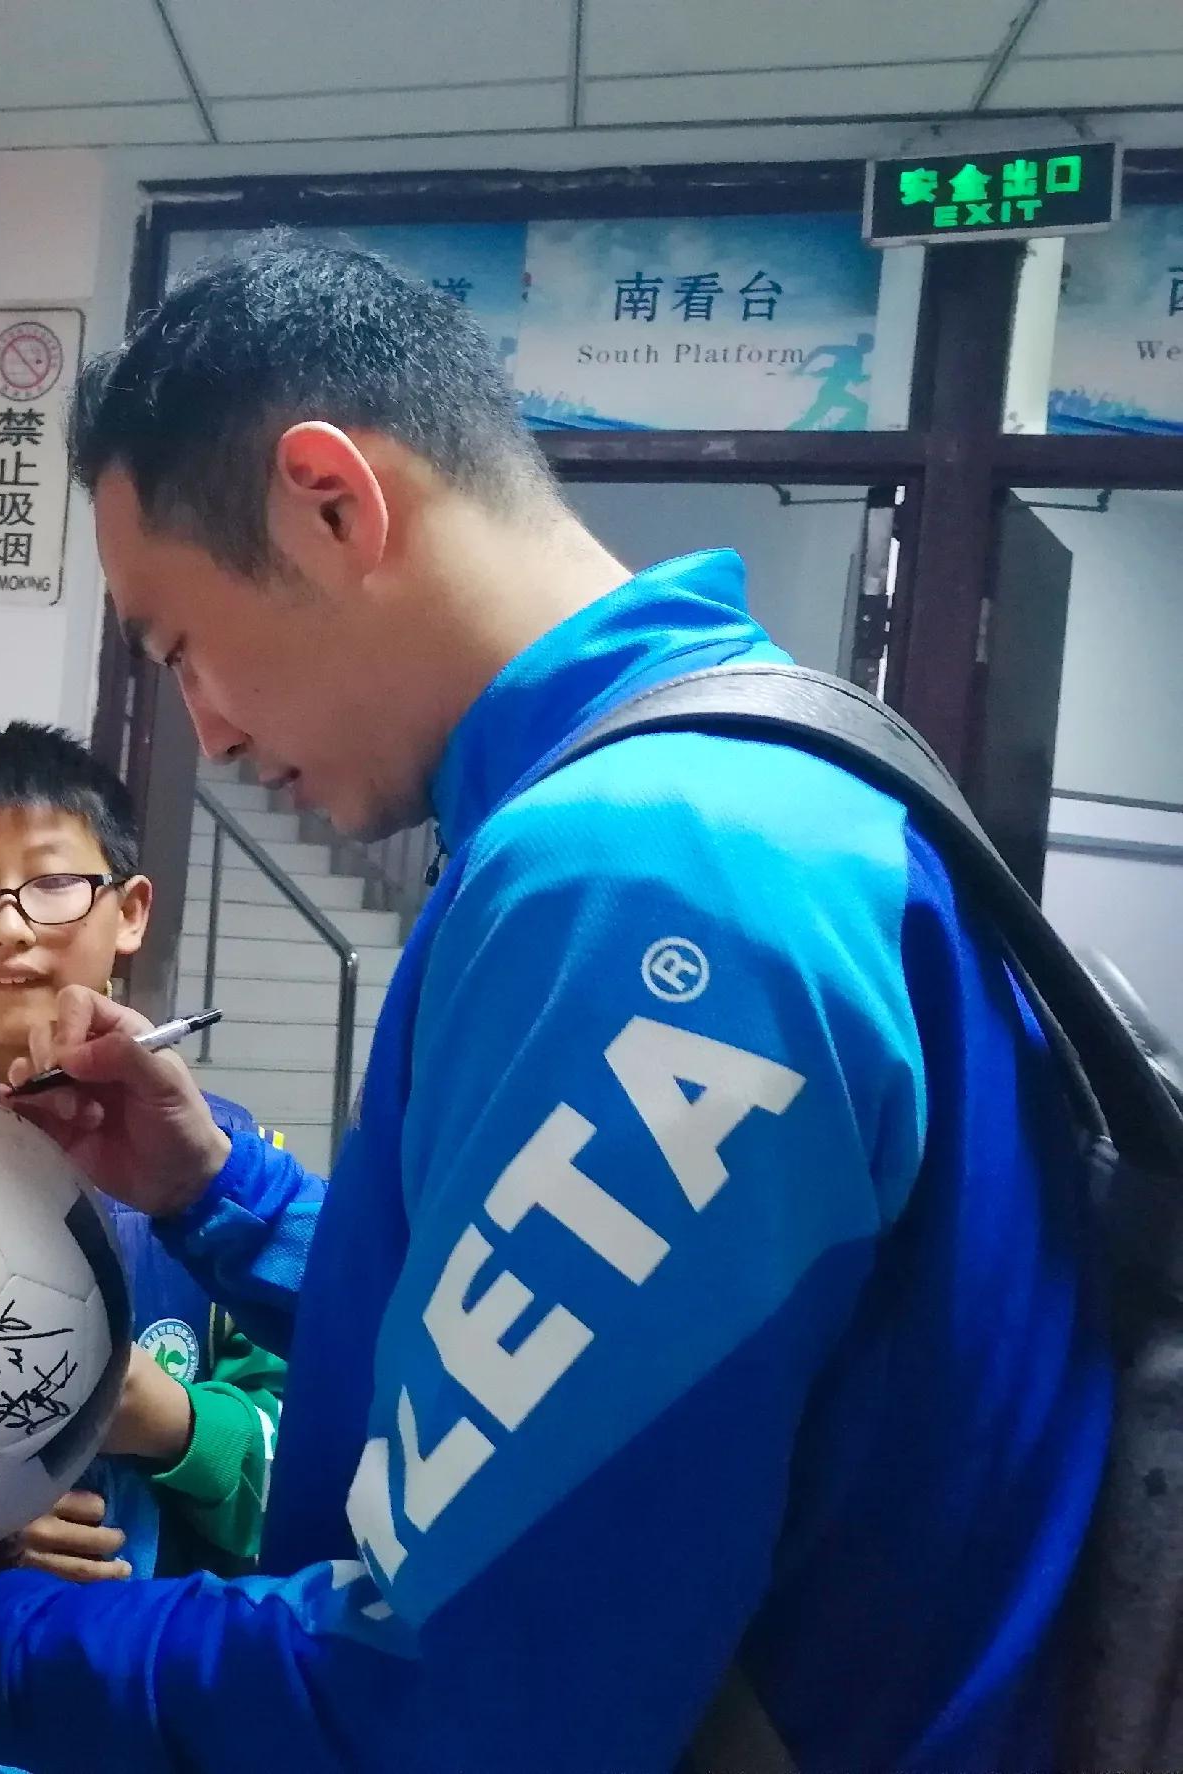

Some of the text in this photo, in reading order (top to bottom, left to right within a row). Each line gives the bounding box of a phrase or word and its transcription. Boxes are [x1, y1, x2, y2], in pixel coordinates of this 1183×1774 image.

[899, 155, 1082, 206] 安全出口
[933, 199, 1043, 228] EXIT
[614, 270, 783, 322] 南看台
[577, 344, 808, 366] South Platform
